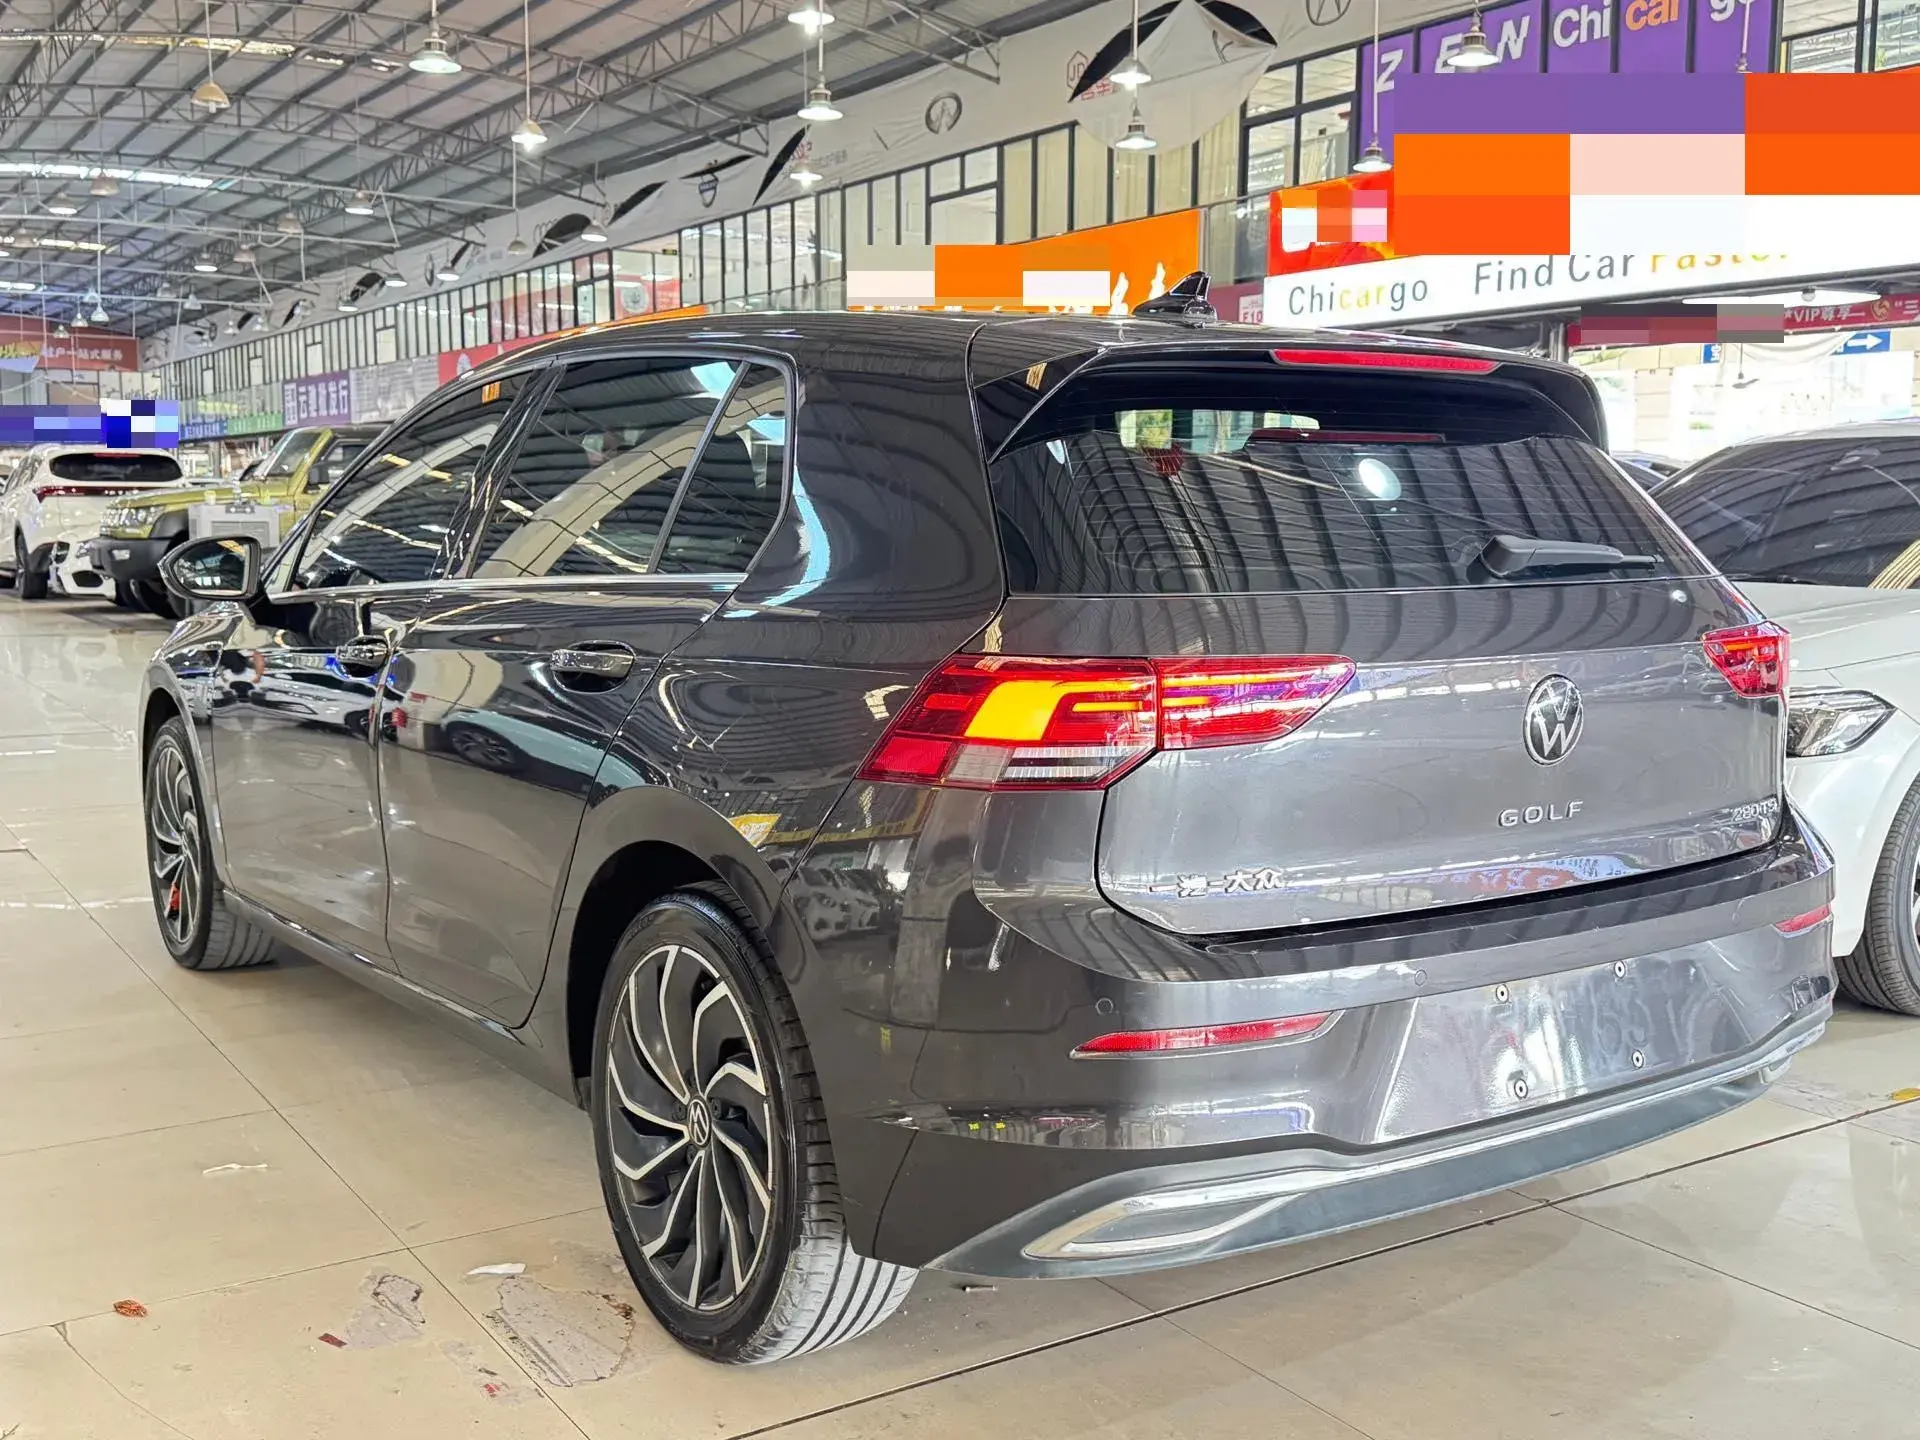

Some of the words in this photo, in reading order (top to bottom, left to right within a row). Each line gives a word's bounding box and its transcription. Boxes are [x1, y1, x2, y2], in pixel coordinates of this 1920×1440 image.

[1289, 279, 1429, 316] Chicargo
[1474, 255, 1554, 295] Find
[1569, 255, 1634, 282] Car
[1498, 800, 1584, 827] GOLF
